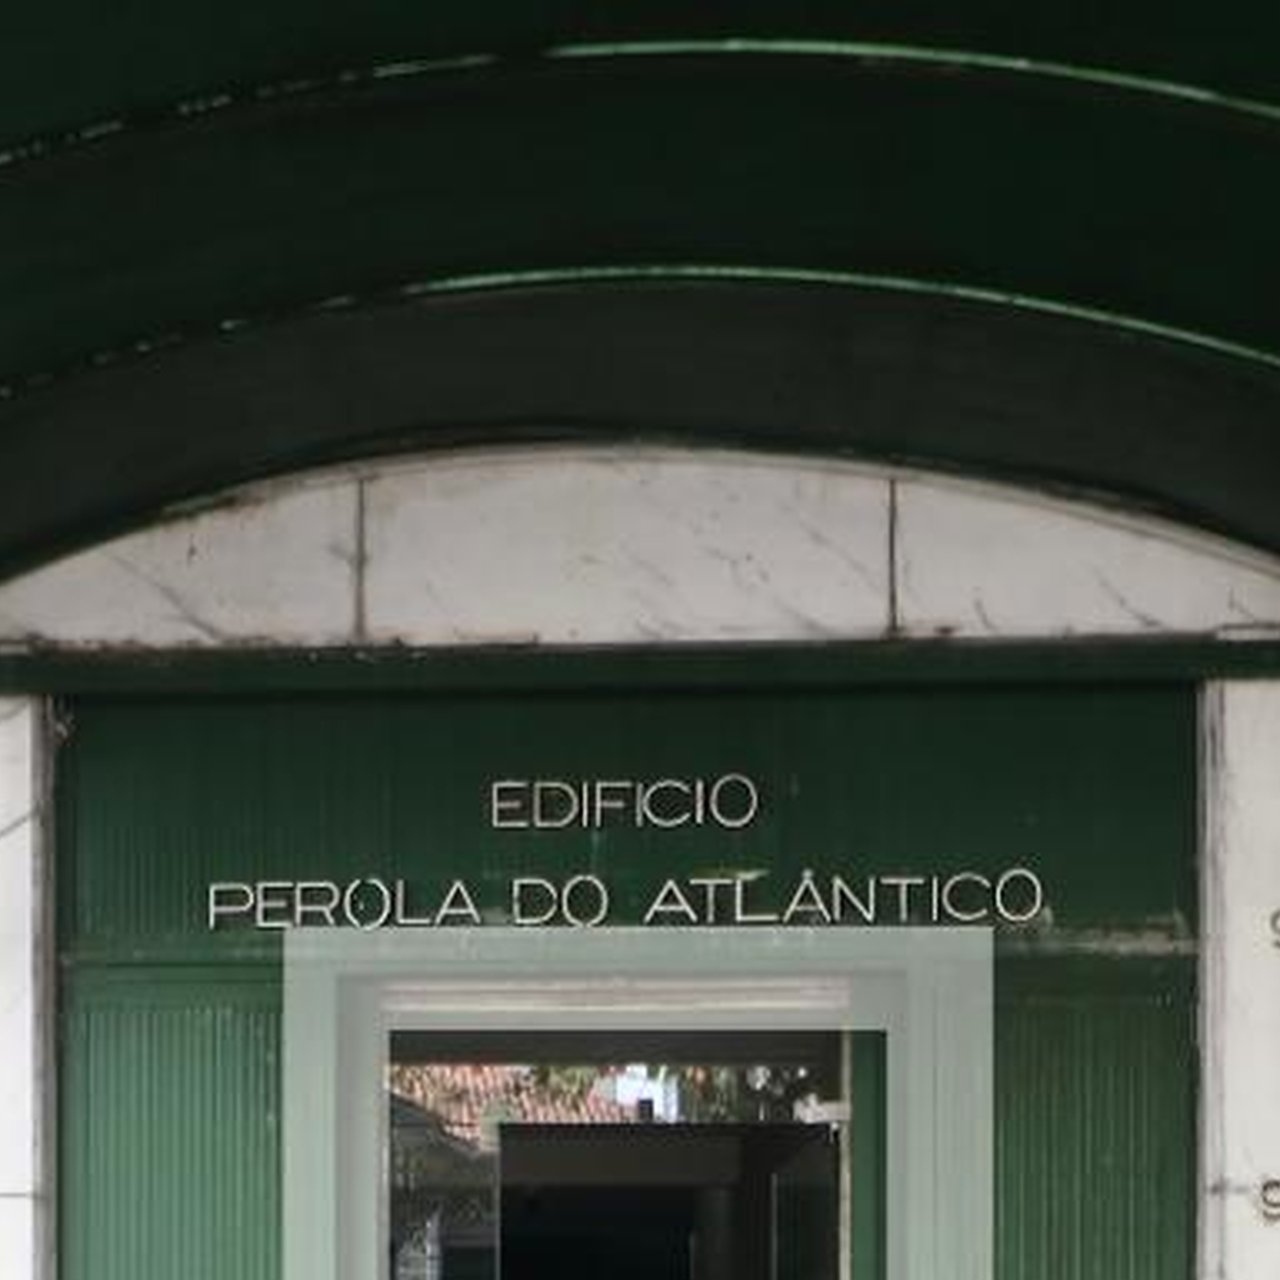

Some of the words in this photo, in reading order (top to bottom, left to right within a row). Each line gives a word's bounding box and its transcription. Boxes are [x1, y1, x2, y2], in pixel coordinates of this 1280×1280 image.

[491, 773, 759, 828] EDIFICIO
[208, 878, 481, 930] PEROLA
[513, 874, 609, 928] DO
